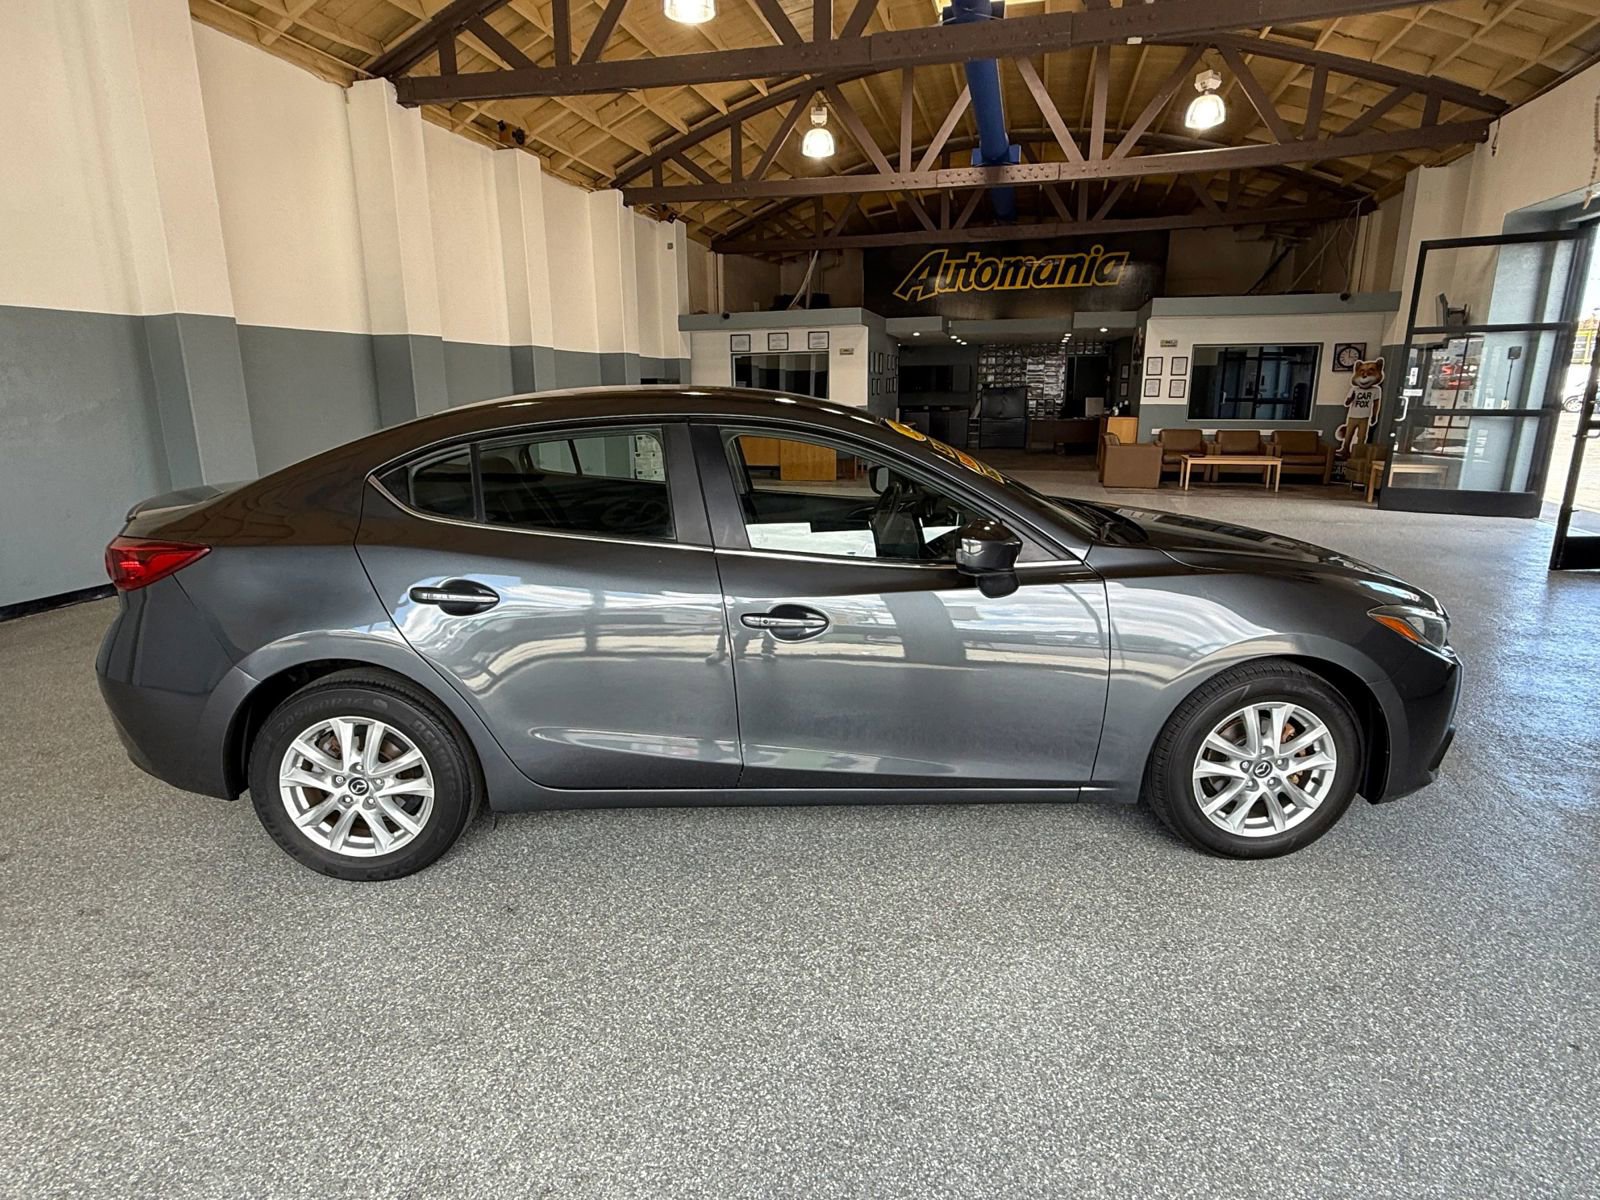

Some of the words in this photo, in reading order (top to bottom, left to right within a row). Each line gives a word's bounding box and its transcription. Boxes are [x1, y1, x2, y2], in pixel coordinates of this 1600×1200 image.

[893, 244, 1130, 301] Automania
[1356, 391, 1372, 400] CAR
[1354, 400, 1370, 408] FOX
